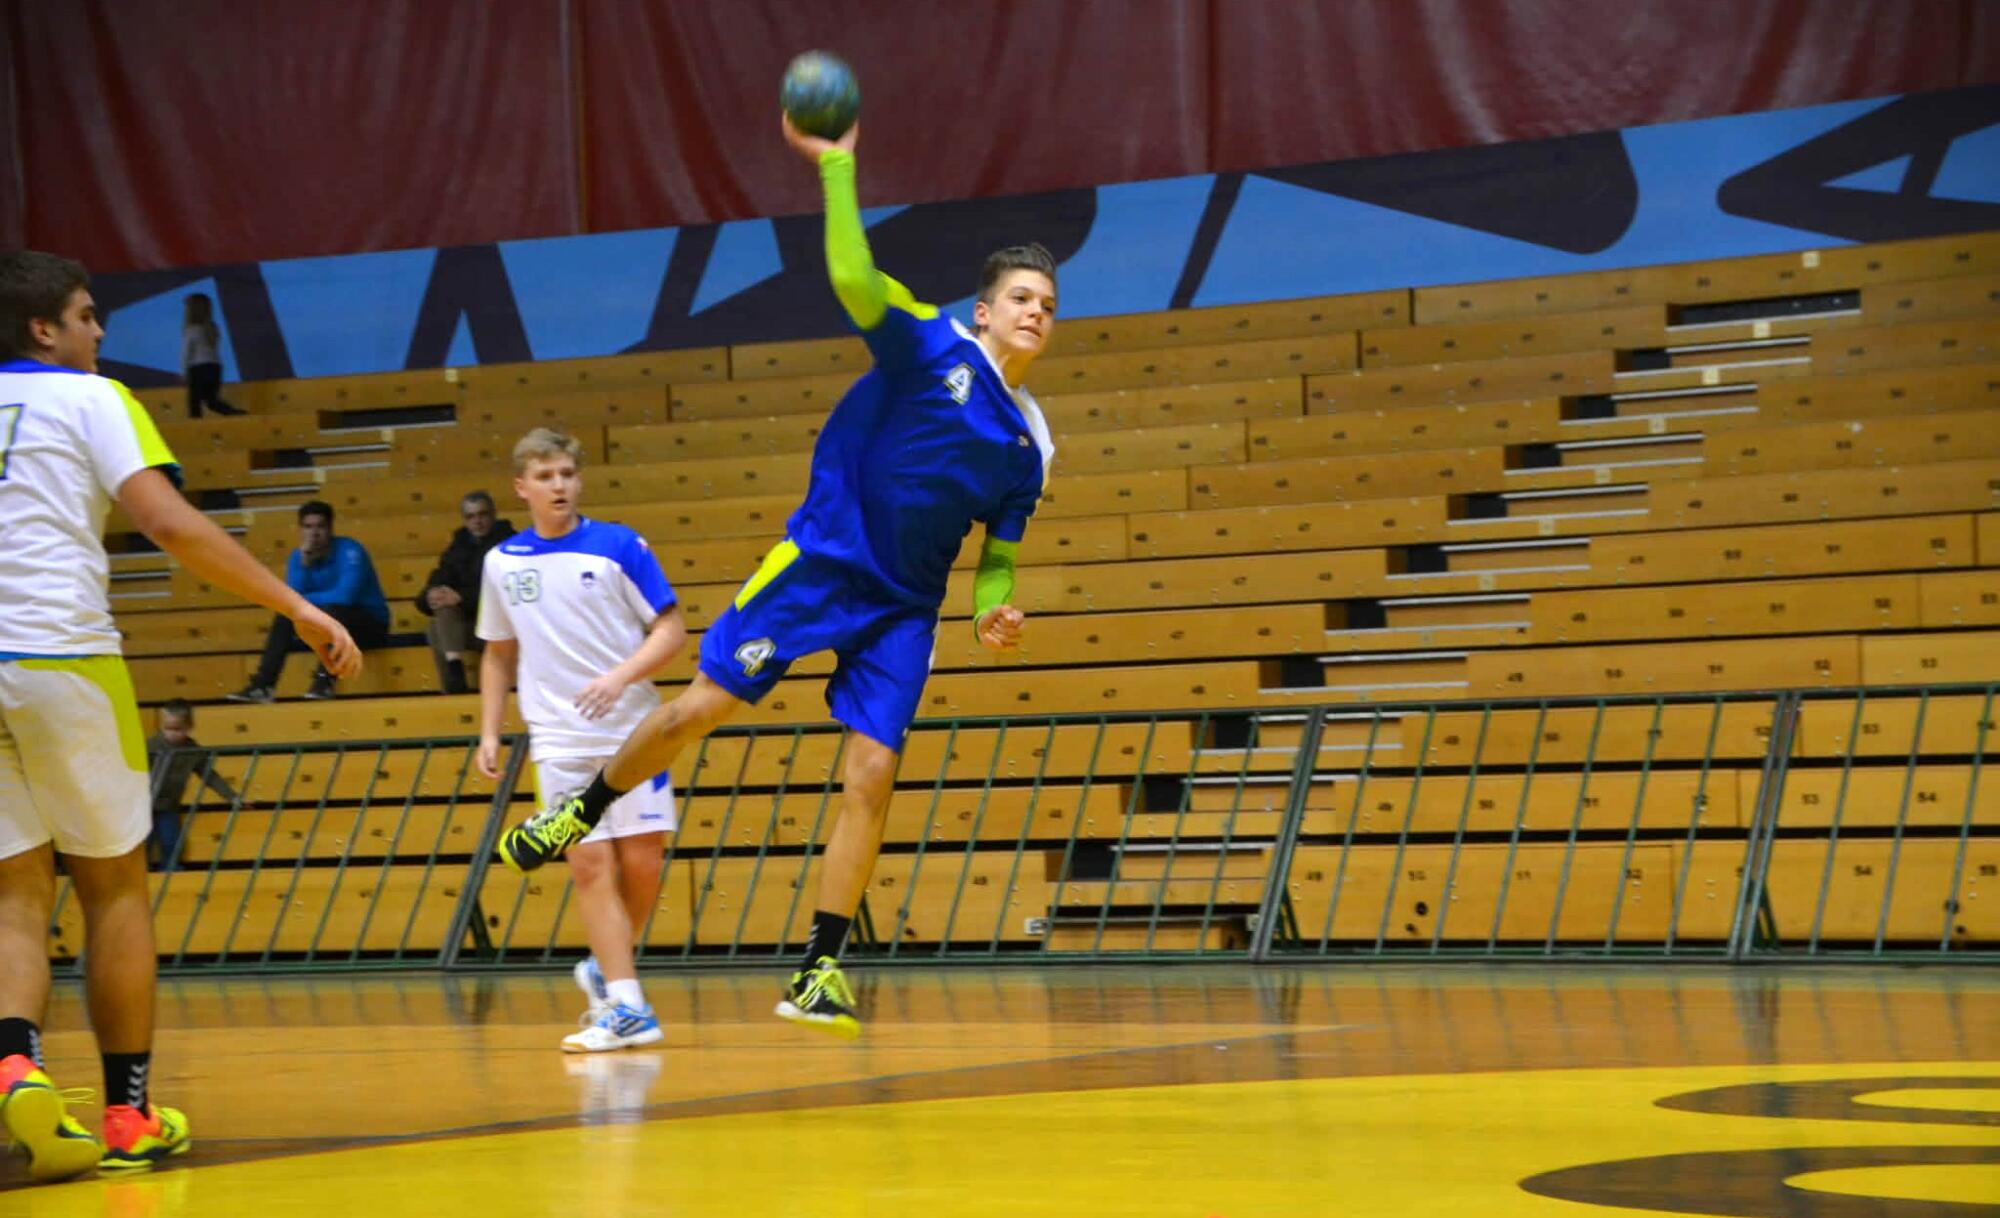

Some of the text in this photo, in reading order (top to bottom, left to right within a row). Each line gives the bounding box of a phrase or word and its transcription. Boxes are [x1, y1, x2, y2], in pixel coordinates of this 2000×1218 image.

[944, 362, 976, 406] 4
[504, 568, 541, 606] 13
[734, 636, 776, 677] 4
